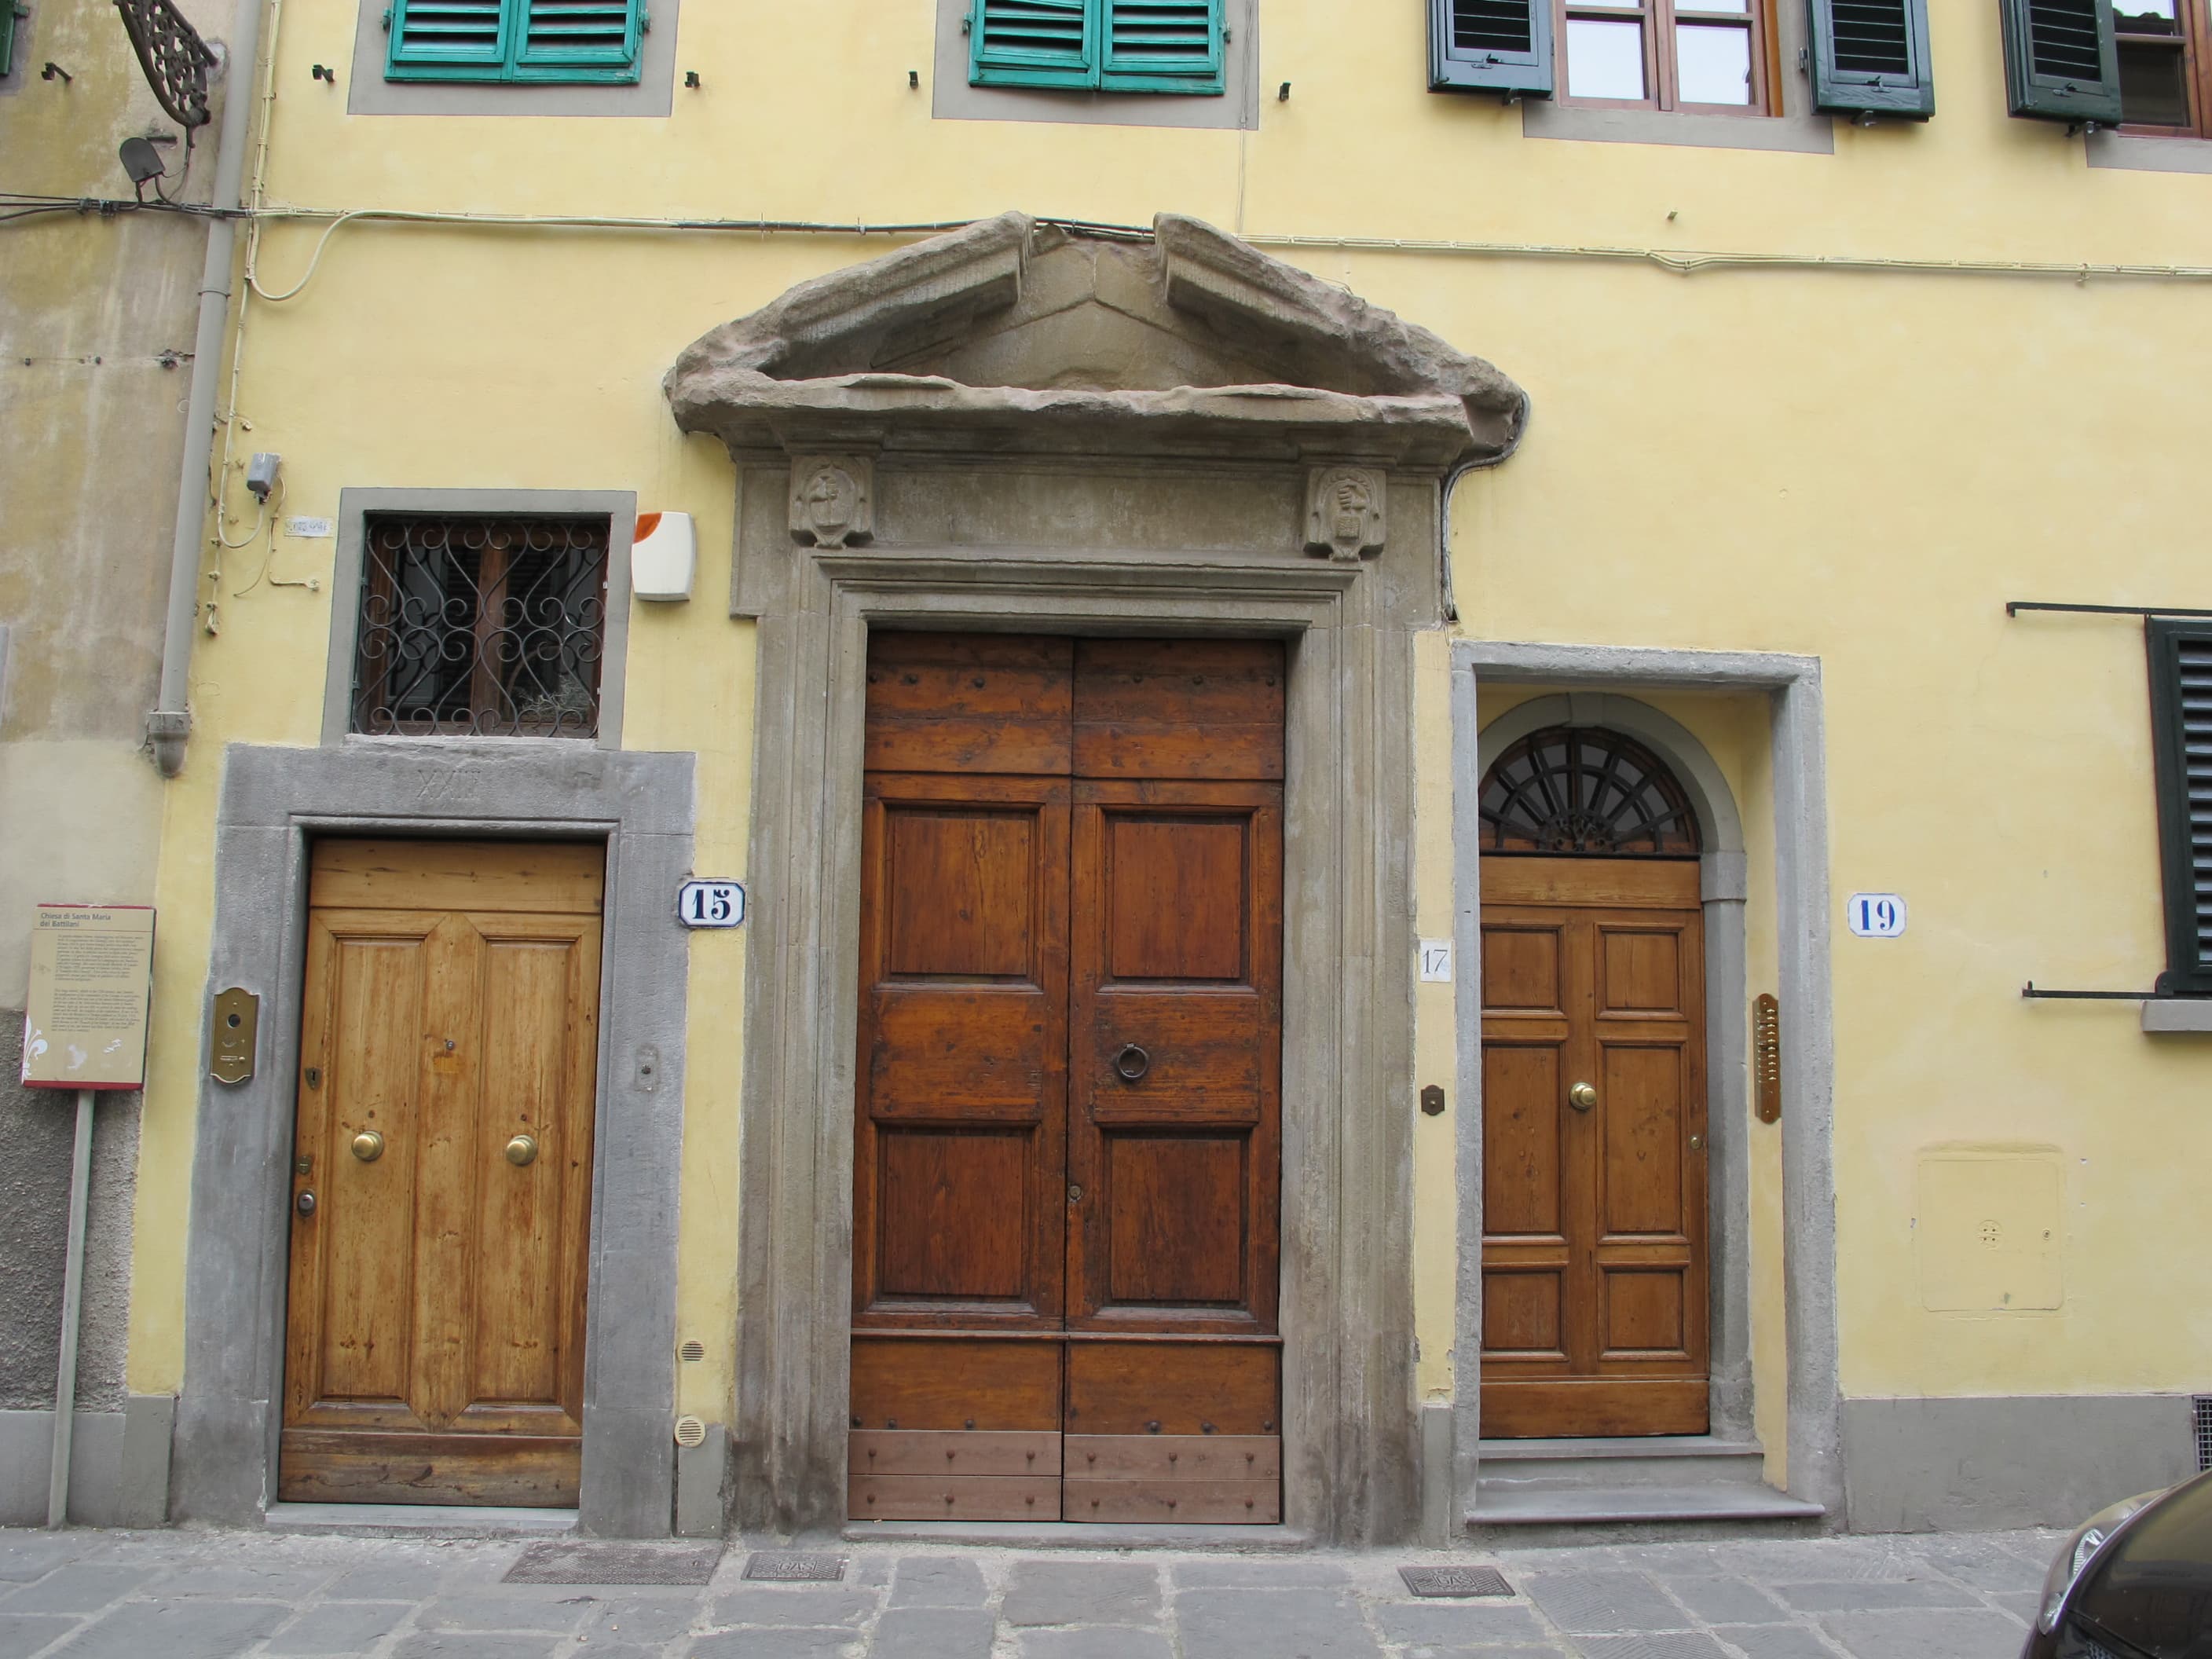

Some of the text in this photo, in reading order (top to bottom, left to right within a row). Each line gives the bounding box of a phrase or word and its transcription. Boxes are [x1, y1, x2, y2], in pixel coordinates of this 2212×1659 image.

[692, 888, 731, 921] 15
[1859, 899, 1895, 932] 19
[1422, 949, 1448, 974] 17
[778, 1562, 815, 1571] GAS
[1437, 1574, 1474, 1585] GAS
